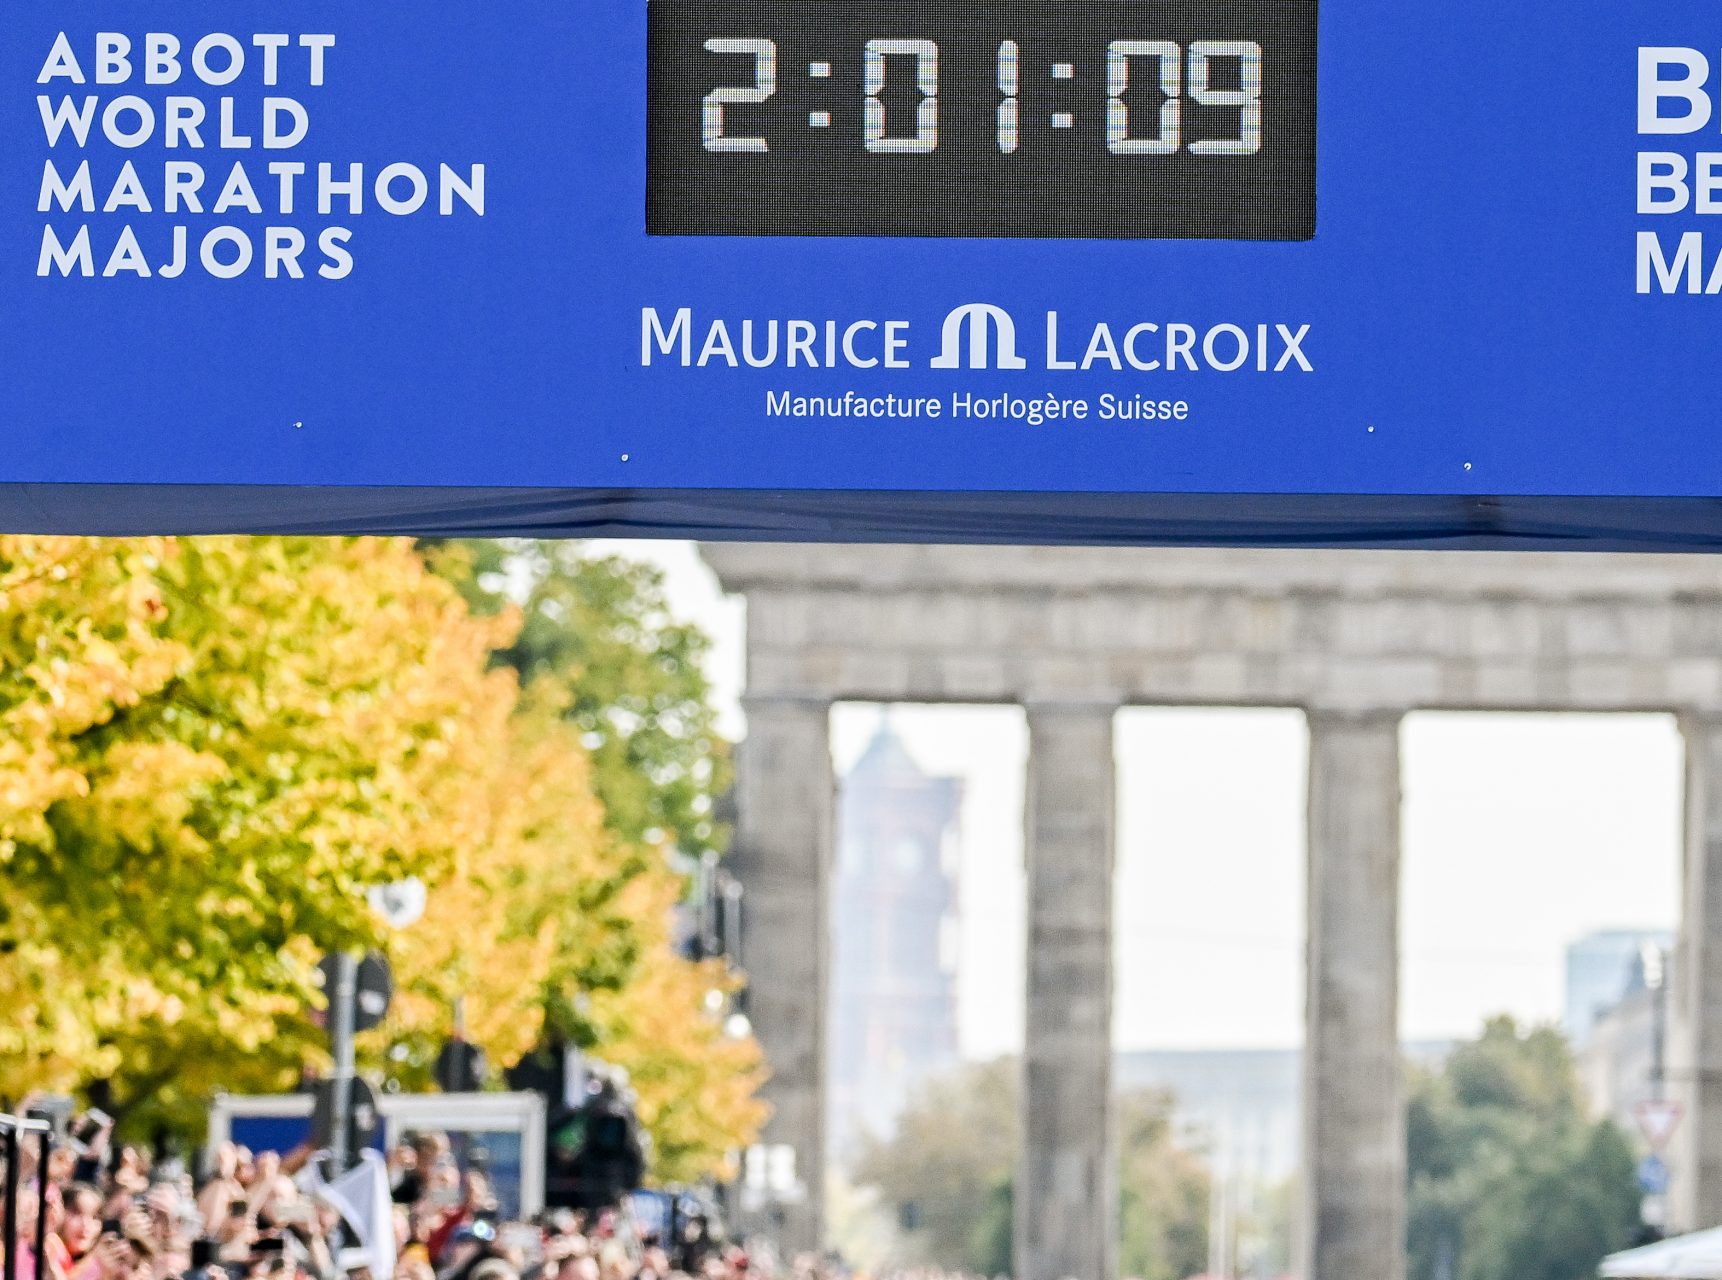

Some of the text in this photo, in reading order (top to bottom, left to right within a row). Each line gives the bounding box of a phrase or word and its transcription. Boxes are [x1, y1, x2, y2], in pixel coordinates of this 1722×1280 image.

[37, 31, 335, 86] ABBOTT
[702, 38, 1262, 154] 2:01:09
[1637, 46, 1722, 135] B
[37, 94, 309, 149] WORLD
[37, 159, 485, 216] MARATHON
[36, 223, 354, 280] MAJORS
[766, 391, 1189, 426] Manufacture Horlogère Suisse
